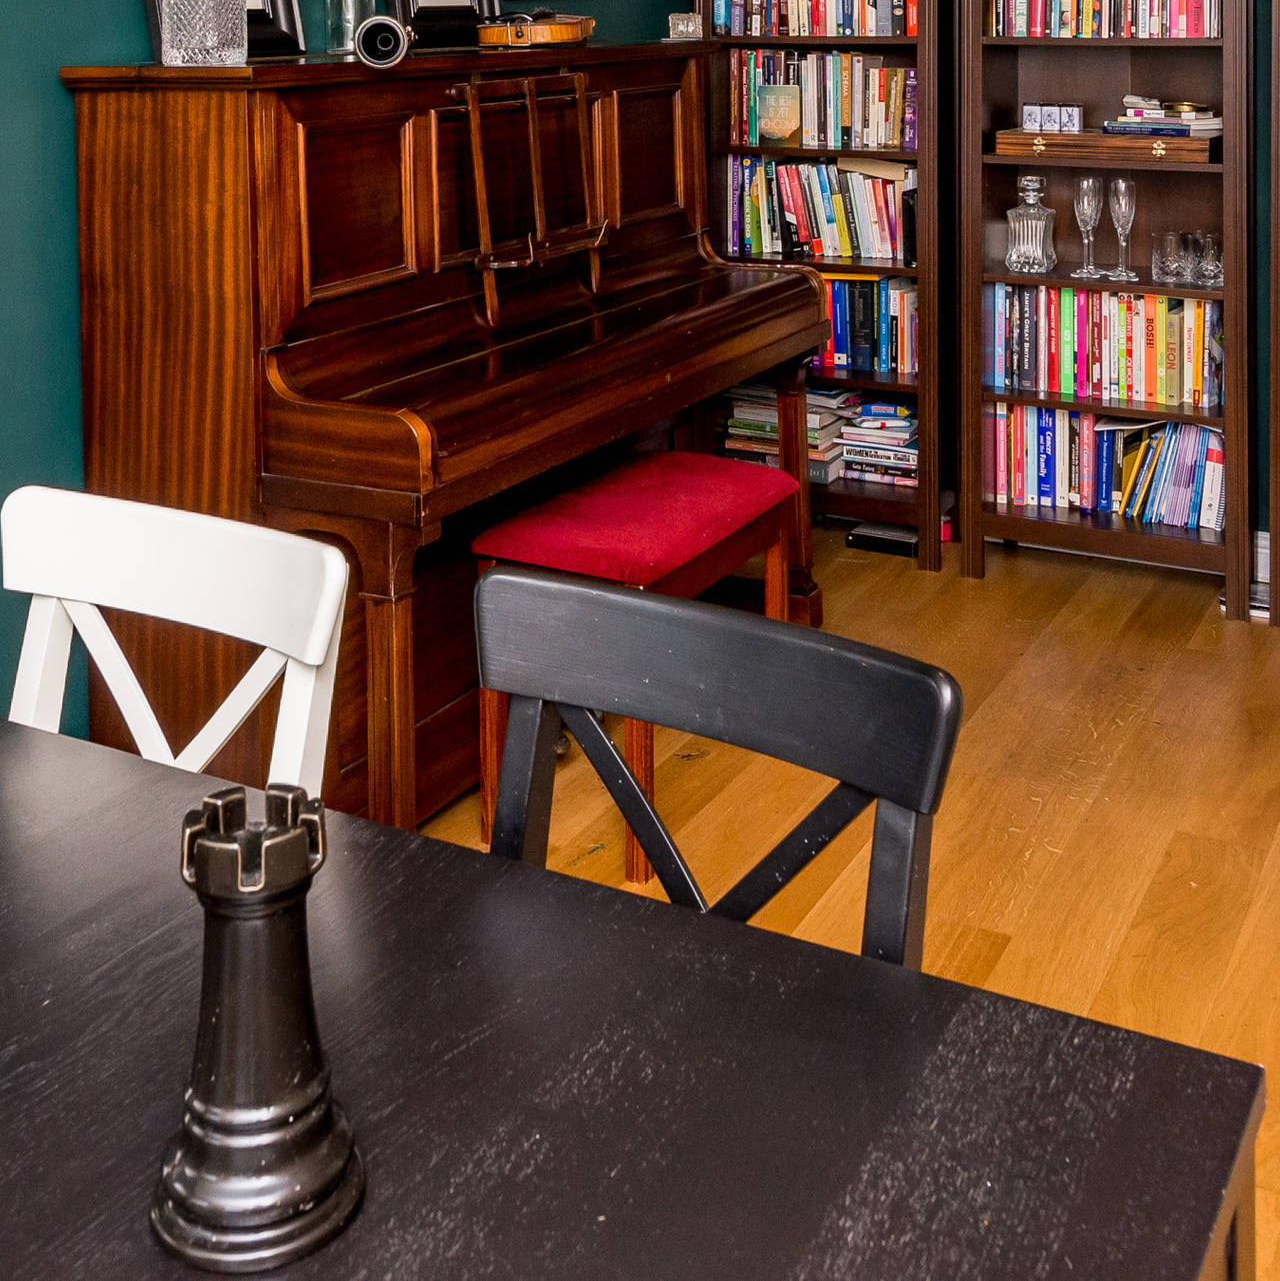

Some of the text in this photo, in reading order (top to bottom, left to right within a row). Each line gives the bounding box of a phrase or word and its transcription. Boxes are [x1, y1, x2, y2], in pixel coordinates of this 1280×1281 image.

[844, 192, 852, 213] Trauma
[745, 214, 750, 223] TO
[1050, 329, 1056, 337] OF
[1146, 318, 1154, 349] BOSH!
[1167, 341, 1176, 370] LEON
[845, 447, 868, 458] WOMEN
